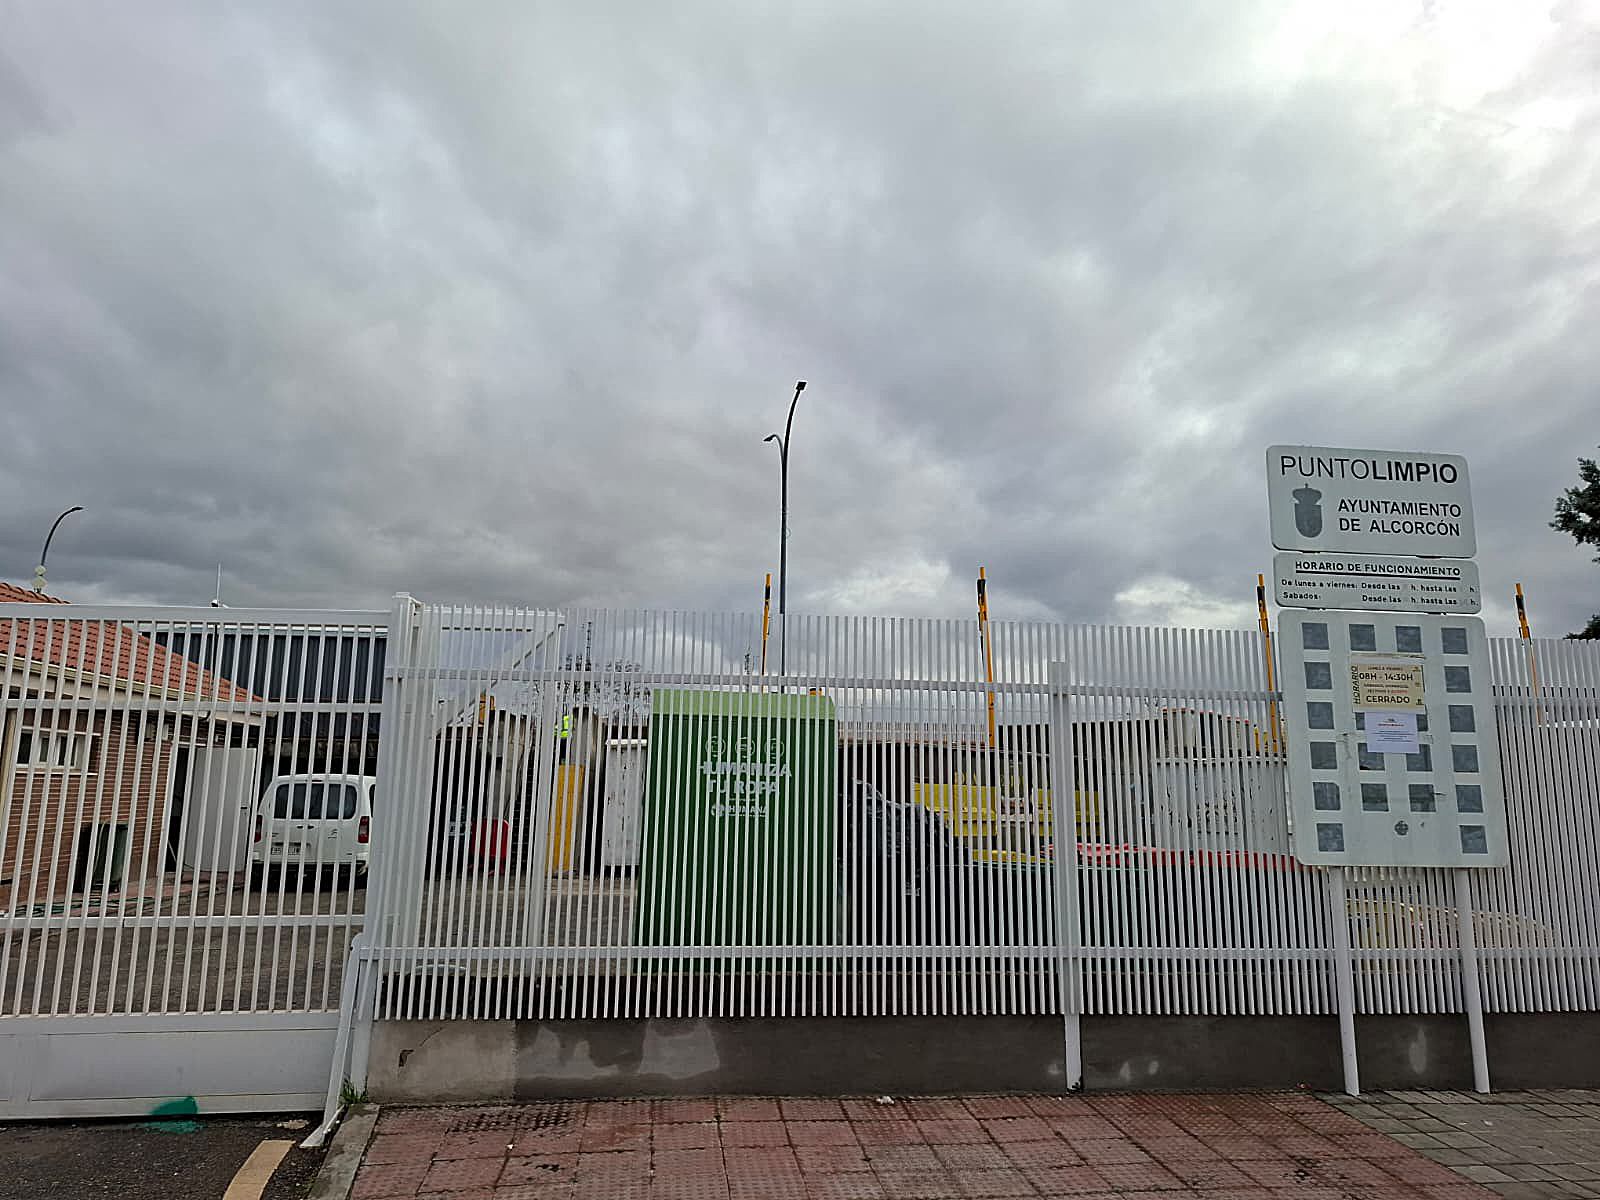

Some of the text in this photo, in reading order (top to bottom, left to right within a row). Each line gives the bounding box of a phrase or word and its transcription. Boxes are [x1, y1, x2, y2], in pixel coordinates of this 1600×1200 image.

[1280, 455, 1458, 484] PUNTOLIMPIO
[1337, 498, 1462, 518] AYUNTAMIENTO
[1339, 518, 1460, 537] DE ALCORCÓN
[1295, 561, 1461, 576] HORARIO DE FUNCIONAMIENTO
[1294, 579, 1316, 587] lunes
[1361, 582, 1386, 590] Desde
[1420, 584, 1442, 592] hasta
[1362, 594, 1387, 602] Desde
[1389, 595, 1401, 603] las
[1421, 597, 1443, 605] hasta
[1445, 597, 1457, 605] las
[1359, 672, 1377, 680] 08H
[1385, 673, 1413, 681] 14:30H
[1351, 665, 1361, 704] HORARIO
[1366, 695, 1410, 704] CERRADO
[699, 761, 792, 777] HUMANIZA
[734, 781, 779, 794] ROPA
